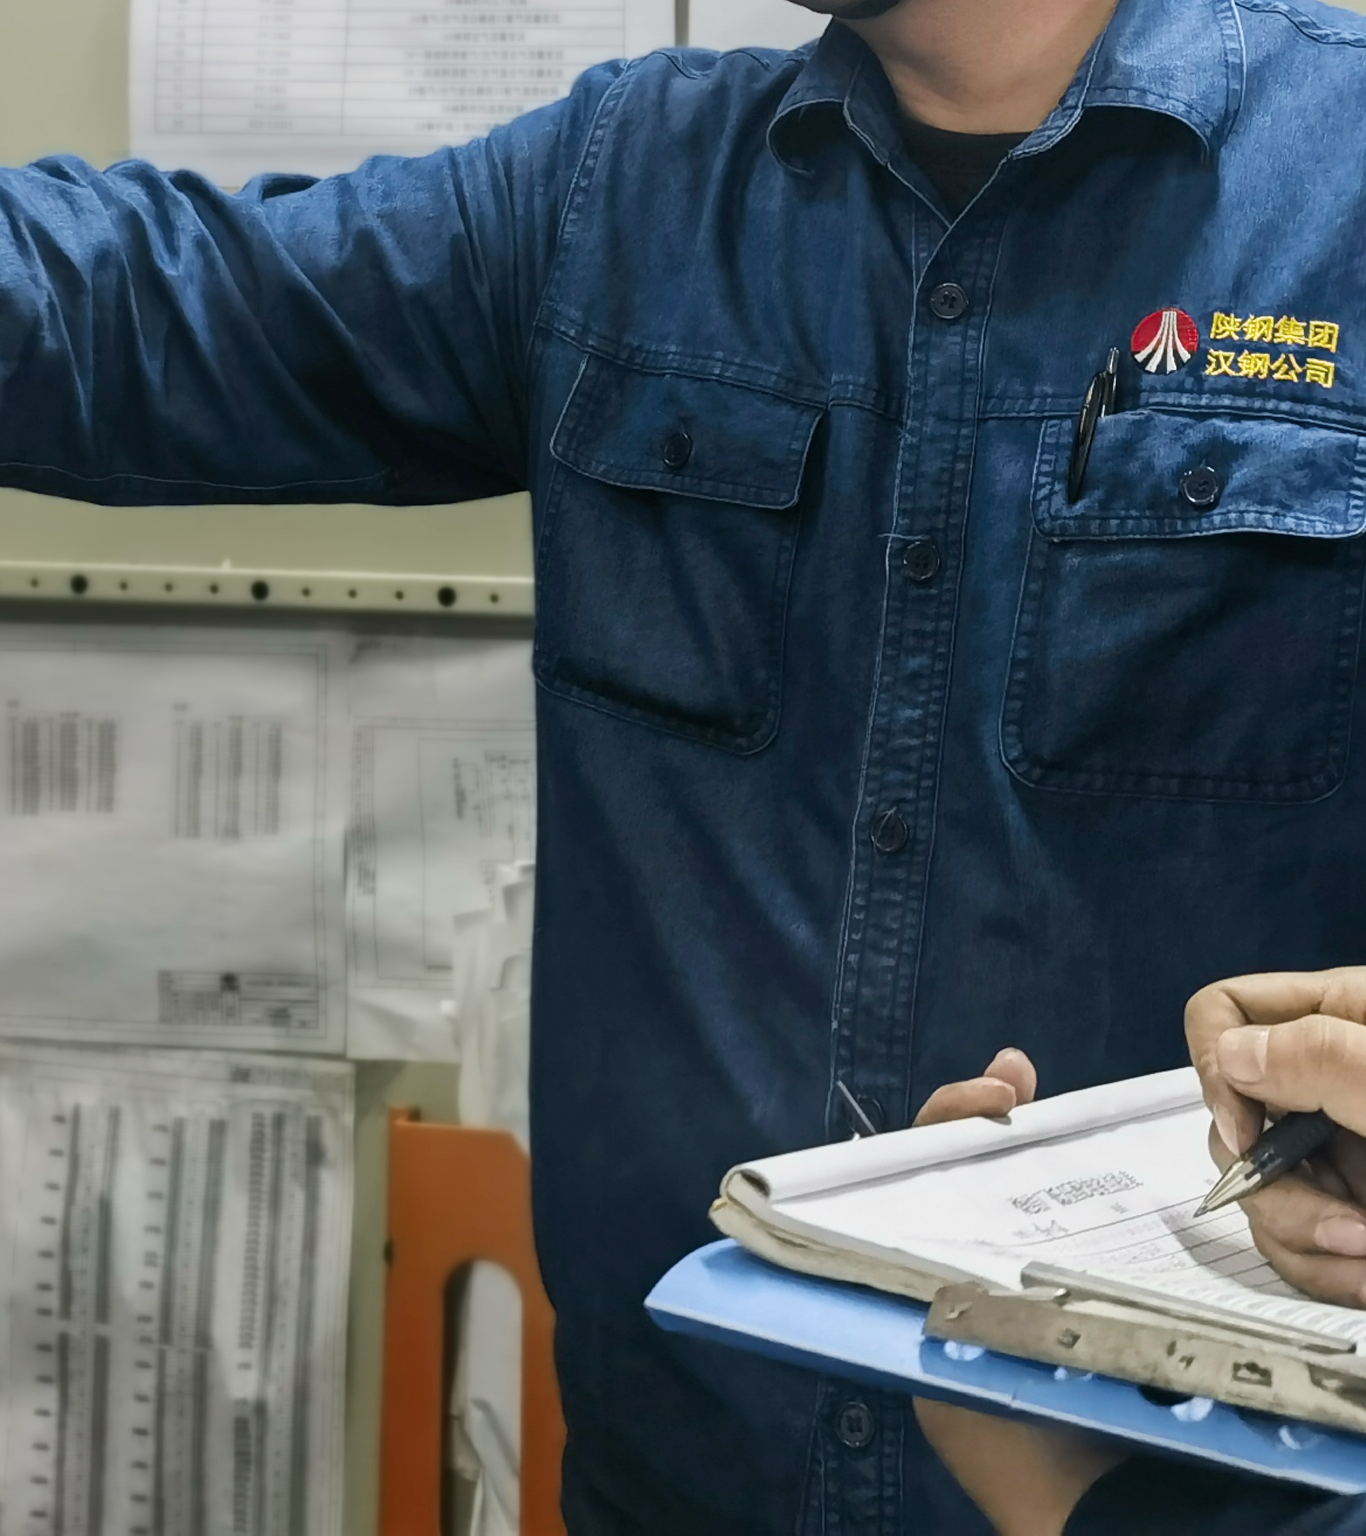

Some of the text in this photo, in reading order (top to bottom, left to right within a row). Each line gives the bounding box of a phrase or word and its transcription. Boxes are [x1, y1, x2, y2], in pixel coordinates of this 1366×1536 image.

[1210, 311, 1339, 353] 陕钢集团
[1204, 348, 1335, 389] 汉钢公司
